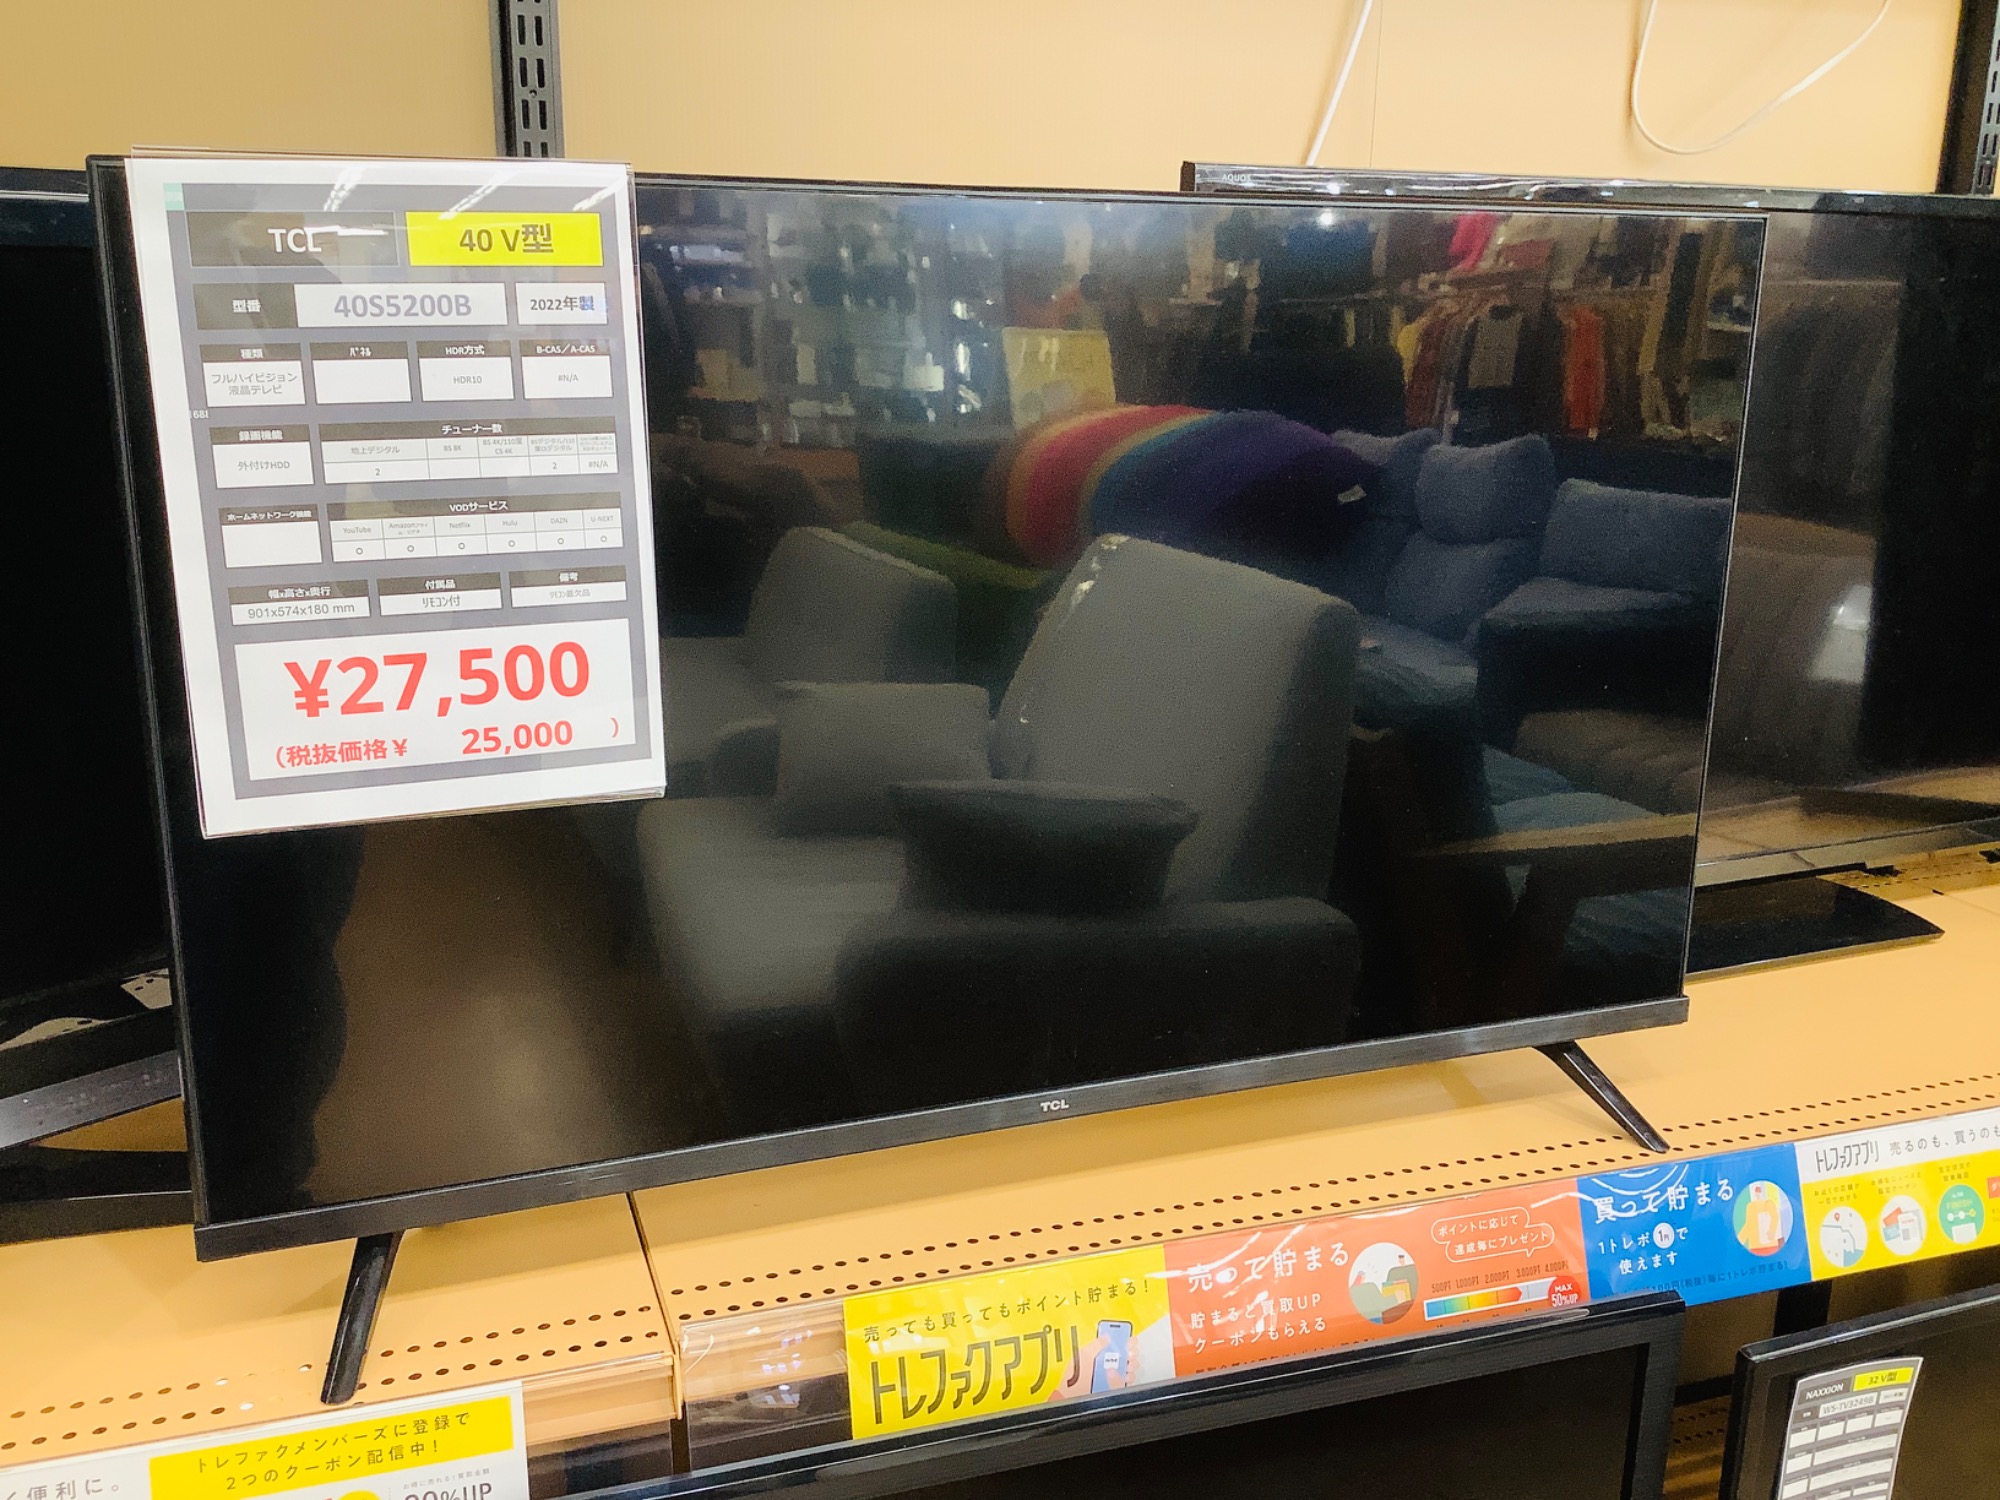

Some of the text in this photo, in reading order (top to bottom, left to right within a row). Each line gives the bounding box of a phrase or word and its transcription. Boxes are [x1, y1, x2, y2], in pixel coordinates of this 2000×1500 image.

[267, 227, 322, 253] TCL
[459, 223, 554, 253] 40 V型
[232, 299, 262, 314] 型番
[333, 293, 473, 319] 40S5200B
[530, 295, 596, 312] 2022年製
[445, 344, 485, 356] HDR方式
[211, 372, 298, 384] フルハイビジョン
[453, 375, 483, 385] HDR10
[557, 374, 579, 383] #N/A
[228, 384, 283, 396] 液晶テレビ
[441, 423, 503, 435] チューナー数
[238, 460, 290, 472] 外付けHDD
[375, 468, 381, 477] 2
[552, 461, 558, 470] 2
[449, 500, 509, 512] VODサービス
[551, 517, 568, 525] DAZN
[343, 526, 372, 535] YouTube
[424, 579, 456, 590] 付属品
[247, 603, 355, 619] 901x574x180 mm
[284, 640, 590, 718] ¥27,500
[461, 719, 574, 756] 25,000
[1040, 1099, 1070, 1112] TCL
[1815, 1139, 1880, 1174] トレファクアプリ
[1594, 1178, 1735, 1225] 買って貯まる
[1437, 1214, 1519, 1238] ポイントに応じて
[1454, 1228, 1549, 1257] 達成毎にプレゼント
[1618, 1250, 1678, 1275] 使えます
[1554, 1283, 1573, 1292] MAX
[1551, 1292, 1579, 1308] 50%UP
[863, 1279, 1150, 1343] 売っても買ってもポイント貯まる!
[1190, 1293, 1322, 1330] 貯まると買取UP
[1195, 1316, 1328, 1355] クーポンもらえる
[870, 1324, 1082, 1425] トレファクアプリ
[197, 1410, 471, 1474] トレファクメンバーズに登録で
[225, 1438, 441, 1491] 2つのクーポン配信中!
